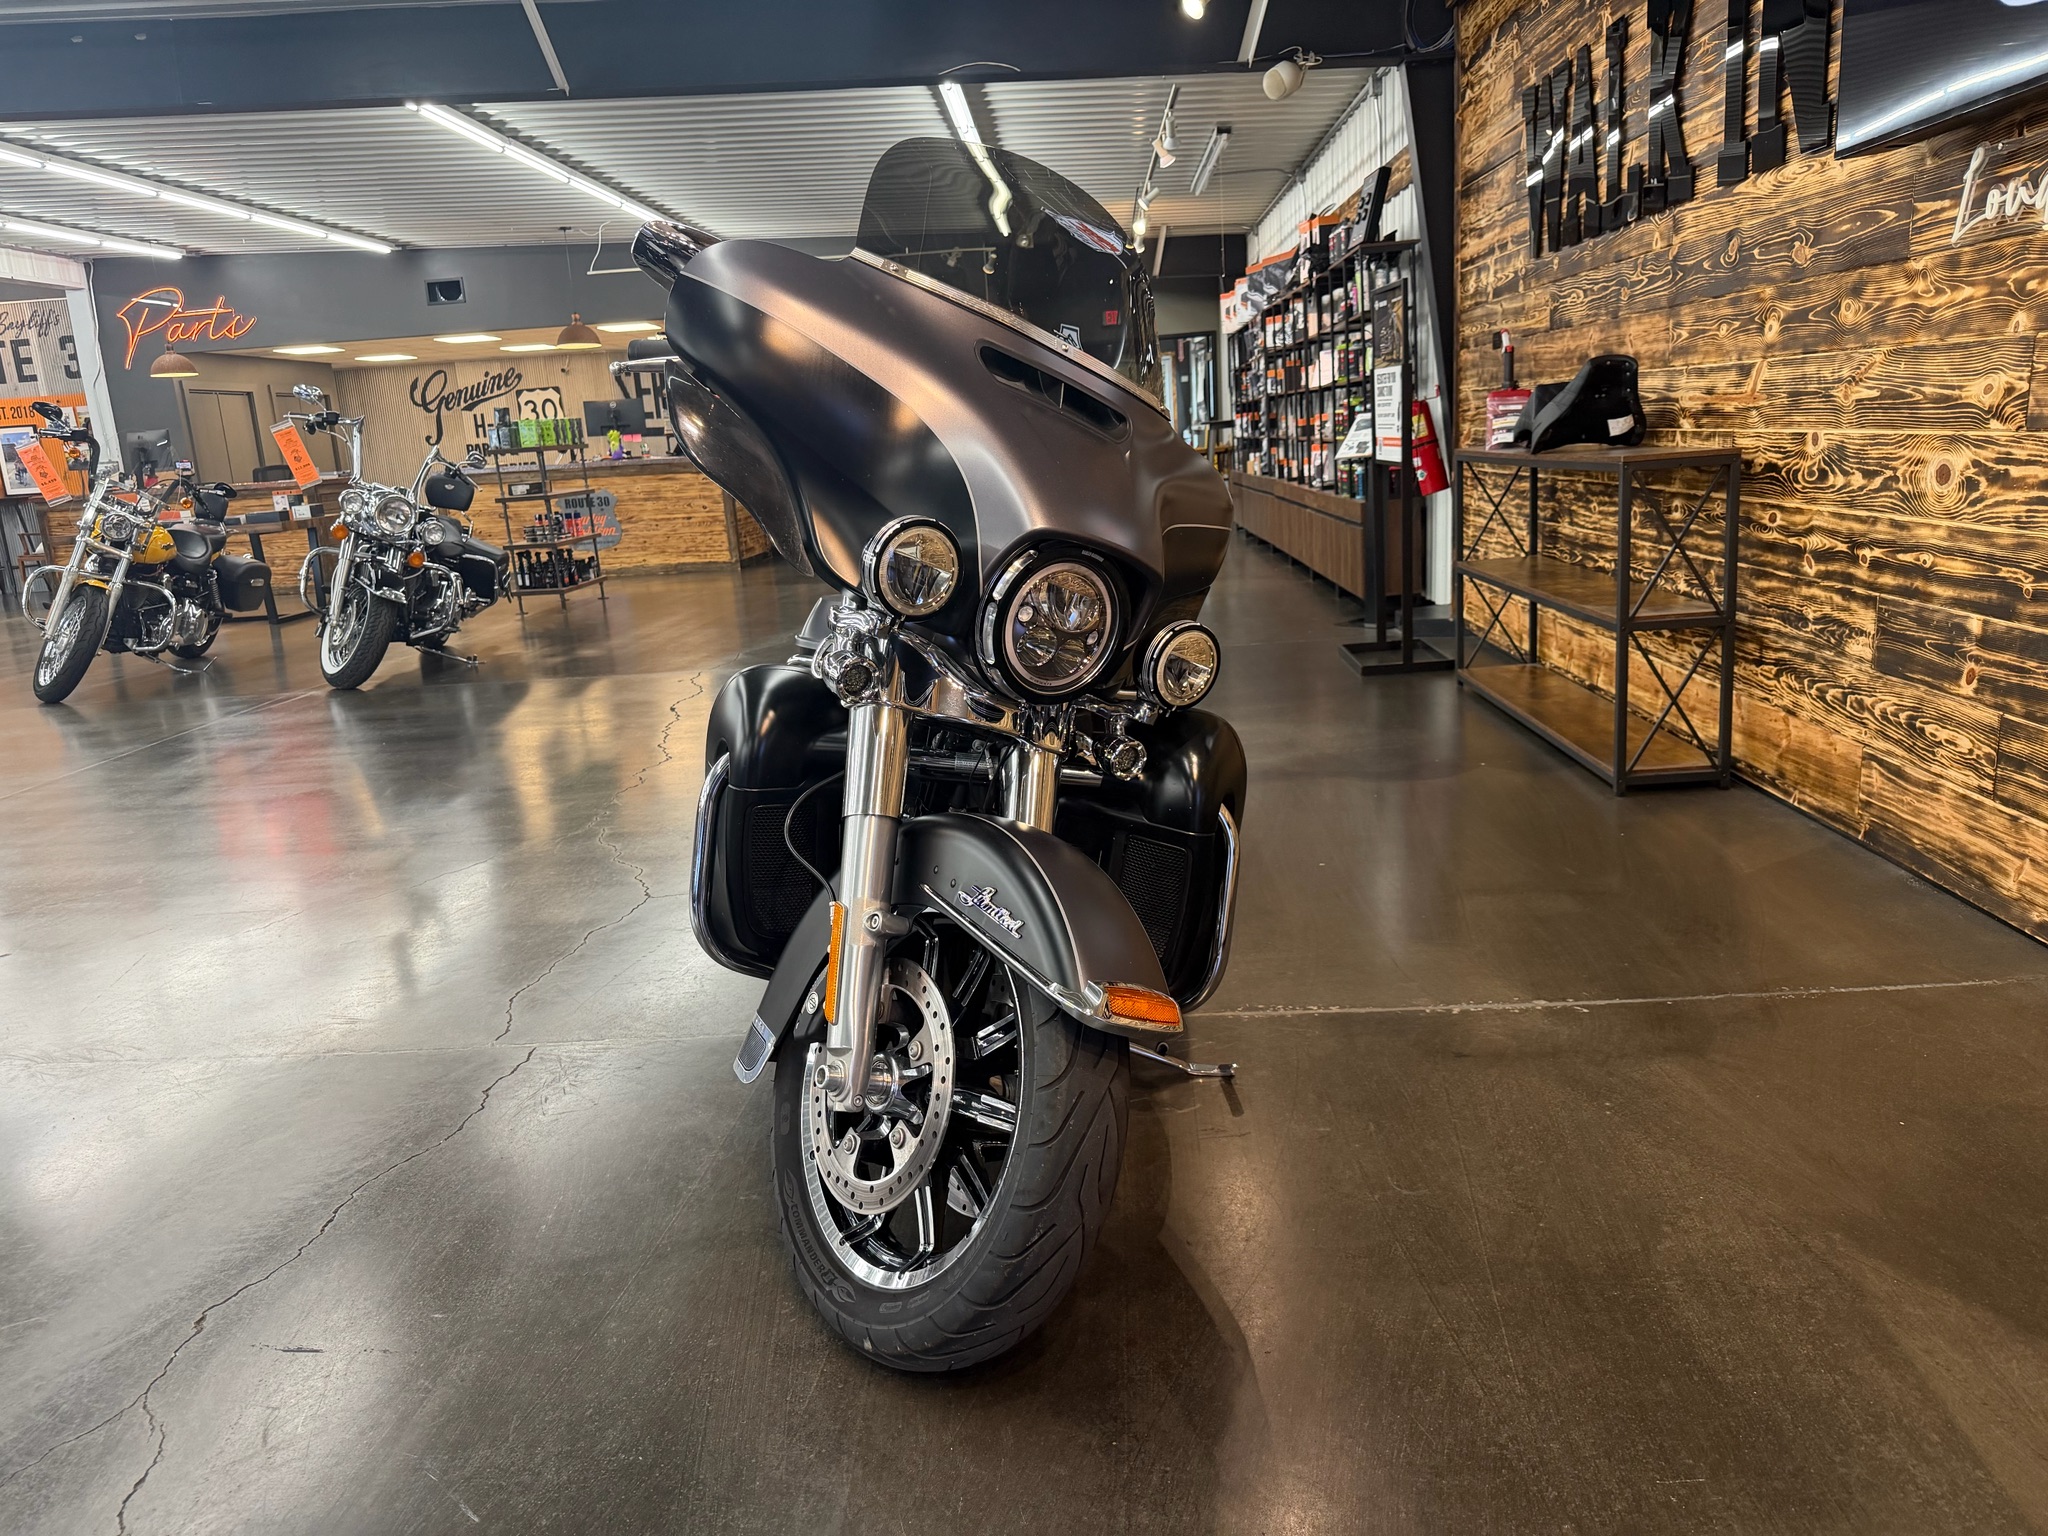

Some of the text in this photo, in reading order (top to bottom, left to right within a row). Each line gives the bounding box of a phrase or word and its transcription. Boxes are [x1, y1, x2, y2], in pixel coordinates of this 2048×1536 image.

[1522, 0, 1831, 258] WALK IN
[117, 286, 257, 370] Parts
[0, 405, 35, 420] T. 2018
[410, 367, 522, 446] Genuine
[473, 413, 494, 438] H-
[524, 398, 557, 420] 30
[564, 496, 610, 509] ROUTE 30
[957, 884, 1025, 939] Limited
[790, 1203, 827, 1273] COMMANDER
